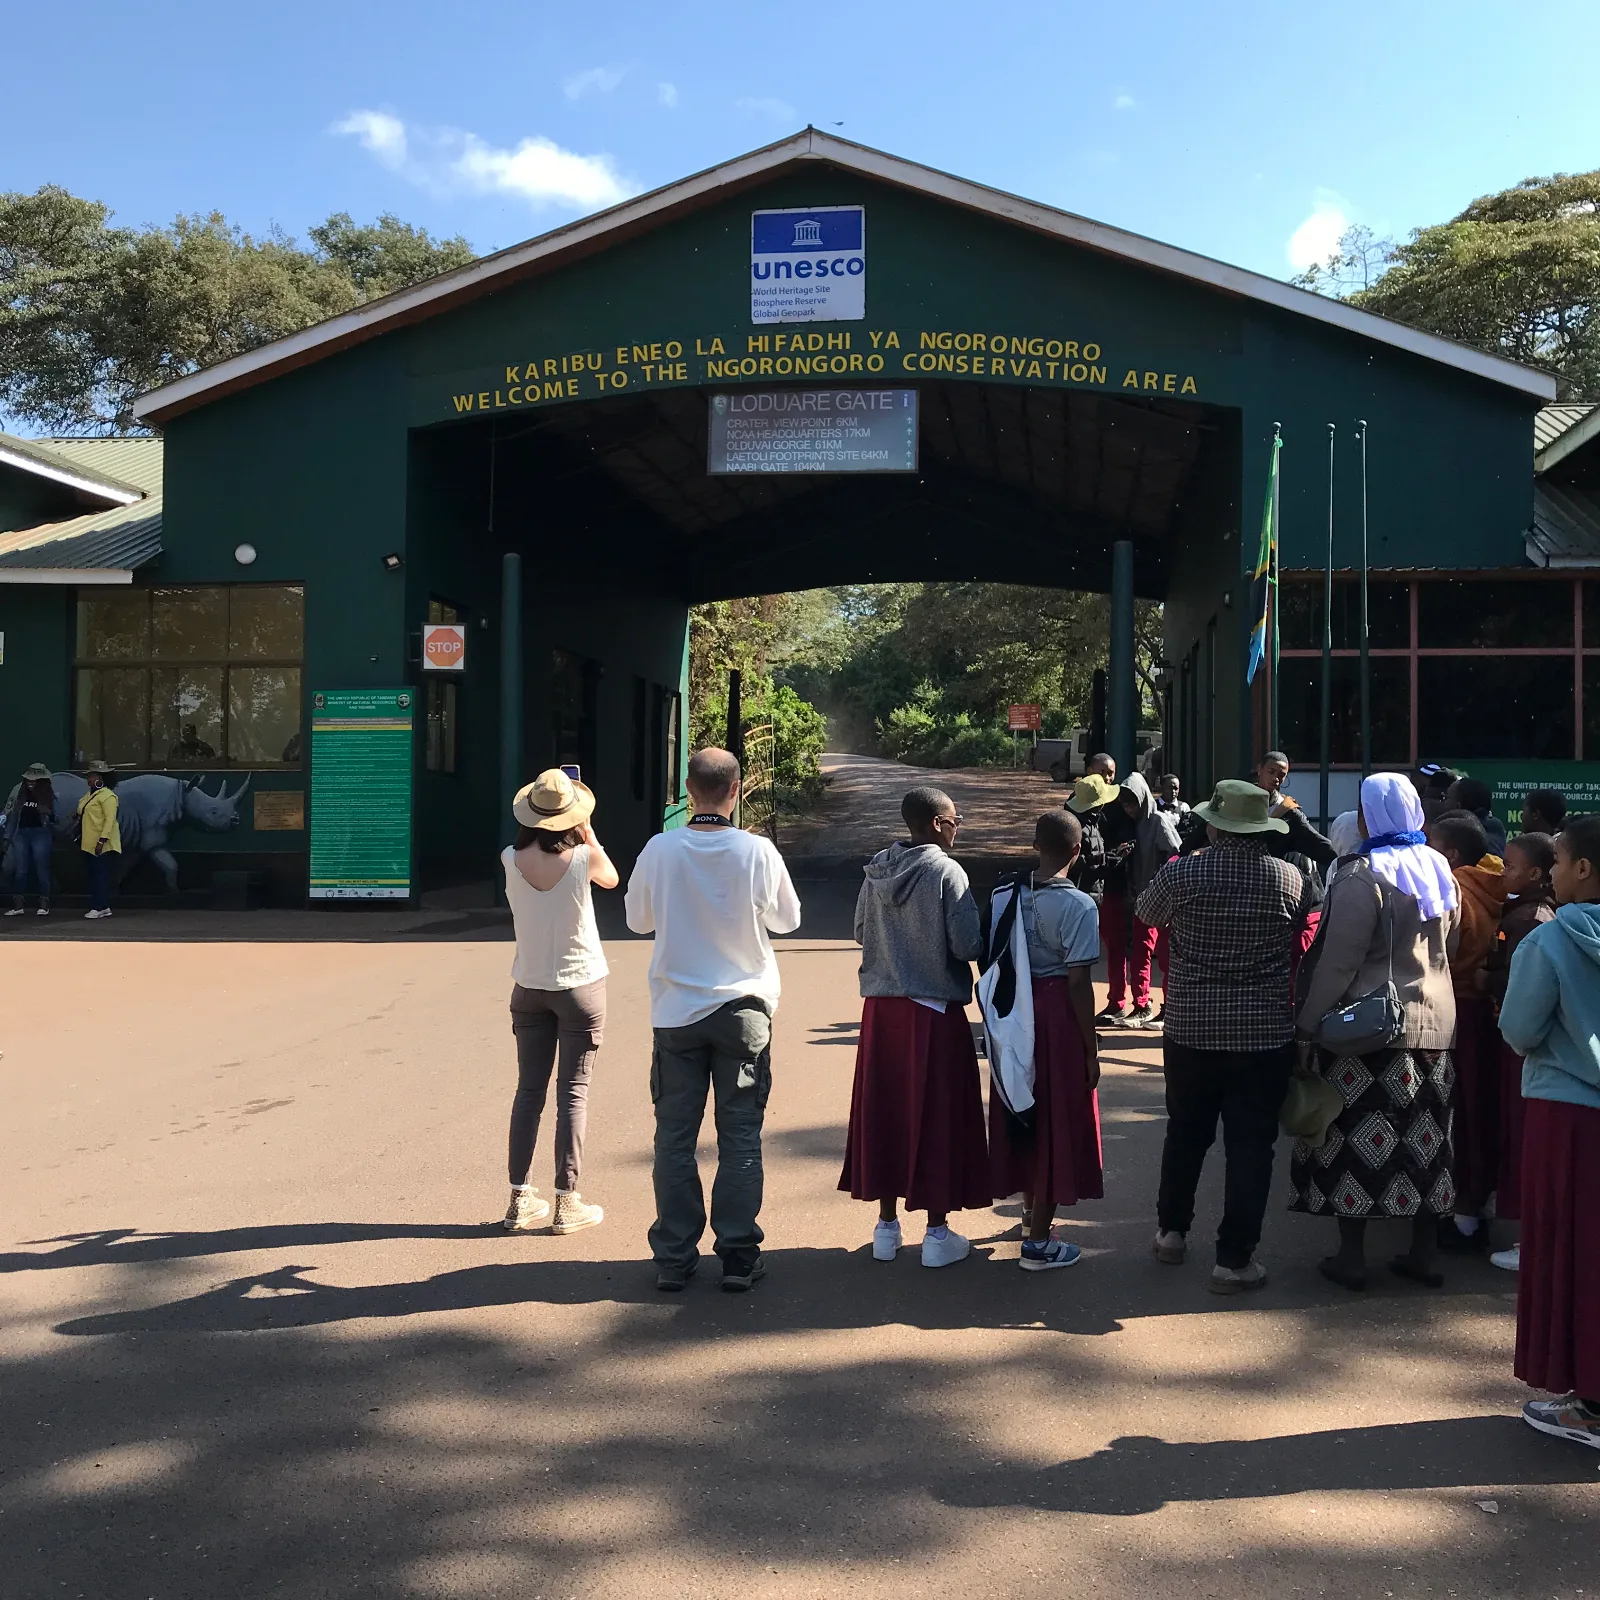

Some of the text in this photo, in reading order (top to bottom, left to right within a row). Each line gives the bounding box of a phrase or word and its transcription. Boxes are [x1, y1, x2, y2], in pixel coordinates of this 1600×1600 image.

[753, 257, 864, 280] unesco
[753, 285, 831, 296] World Heritage Site
[753, 297, 827, 308] Biosphere Reserve
[753, 308, 816, 318] Global Geopark
[506, 331, 1101, 384] KARIBU ENEO LA HIFADHI YA NGORONGORO
[452, 353, 1198, 412] WELCOME TO THE NGORONGORO CONSERVATION AREA
[730, 393, 831, 412] LODUARE
[835, 392, 893, 410] GATE
[727, 417, 858, 429] CRATER VIEW POINT 6KM
[727, 428, 871, 439] NCAA HEADQUARTERS 17KM
[727, 440, 842, 451] OLDUVAI GORGE 61KM
[727, 450, 888, 462] LAETOLI FOOTPRINTS SITE 64KM
[727, 461, 825, 472] NAABI GATE 104KM
[427, 641, 461, 653] STOP
[1540, 782, 1572, 790] REPUBLIC
